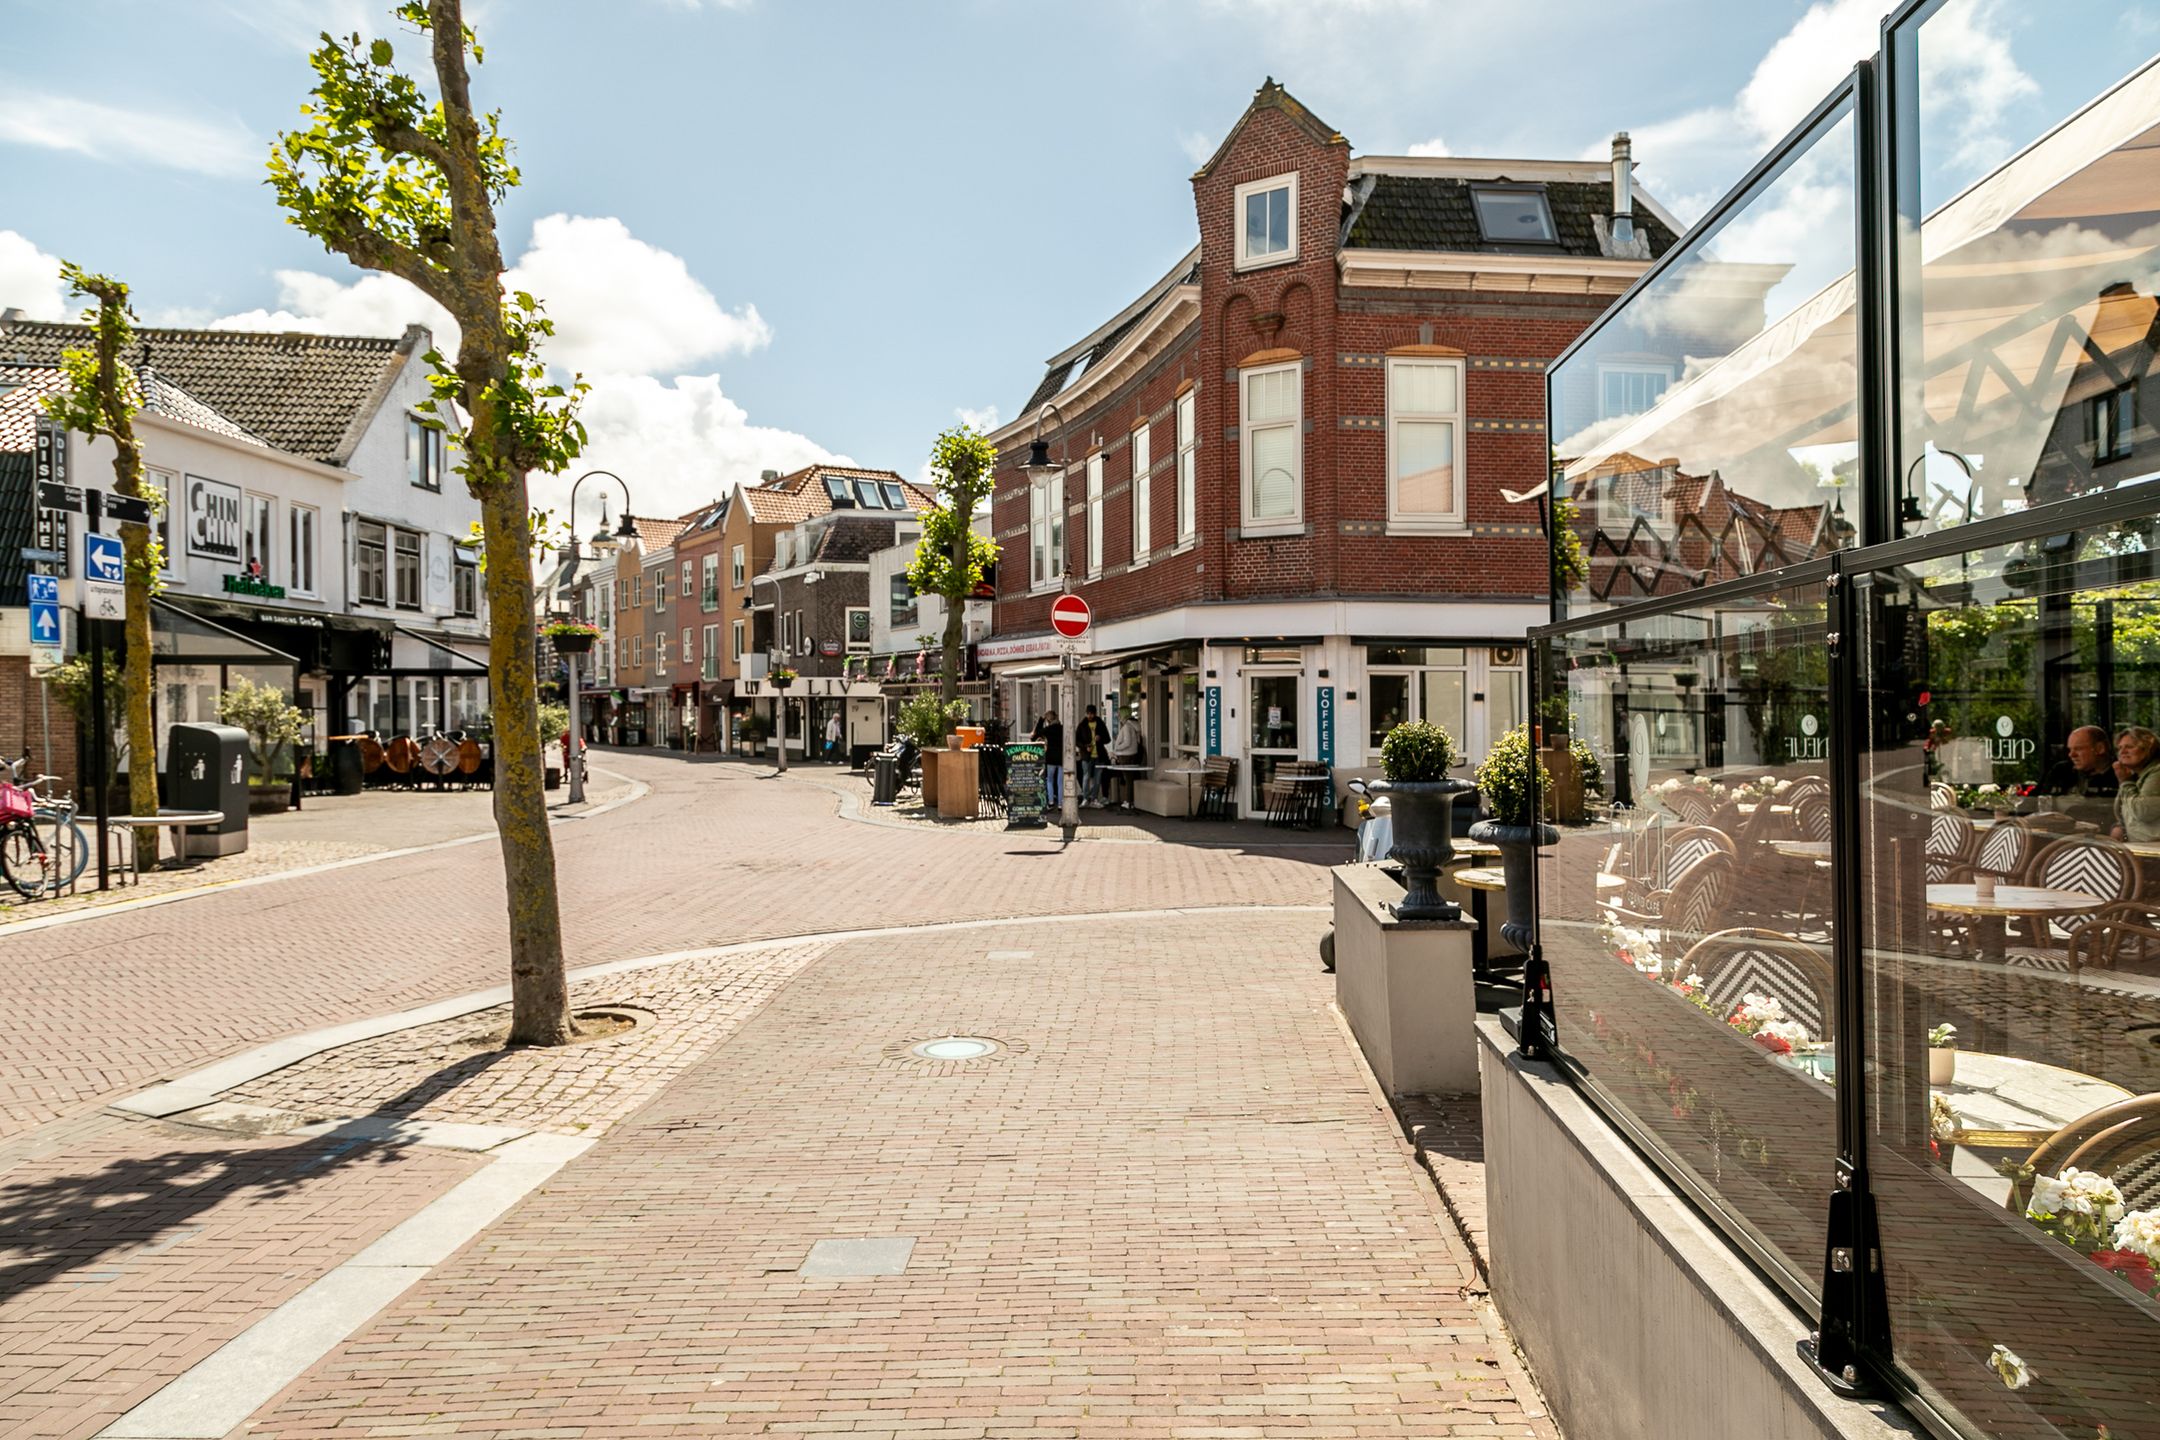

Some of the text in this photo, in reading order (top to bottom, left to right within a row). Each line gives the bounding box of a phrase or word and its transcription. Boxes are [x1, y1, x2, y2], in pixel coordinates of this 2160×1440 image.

[38, 436, 52, 575] DISTHEK
[56, 438, 67, 577] DISHEEK
[191, 482, 237, 523] CHIN
[191, 509, 237, 548] CHIN
[745, 681, 760, 695] LIV
[807, 679, 852, 695] LIV
[1209, 688, 1218, 748] COFFEE
[1321, 688, 1330, 751] COFFEE
